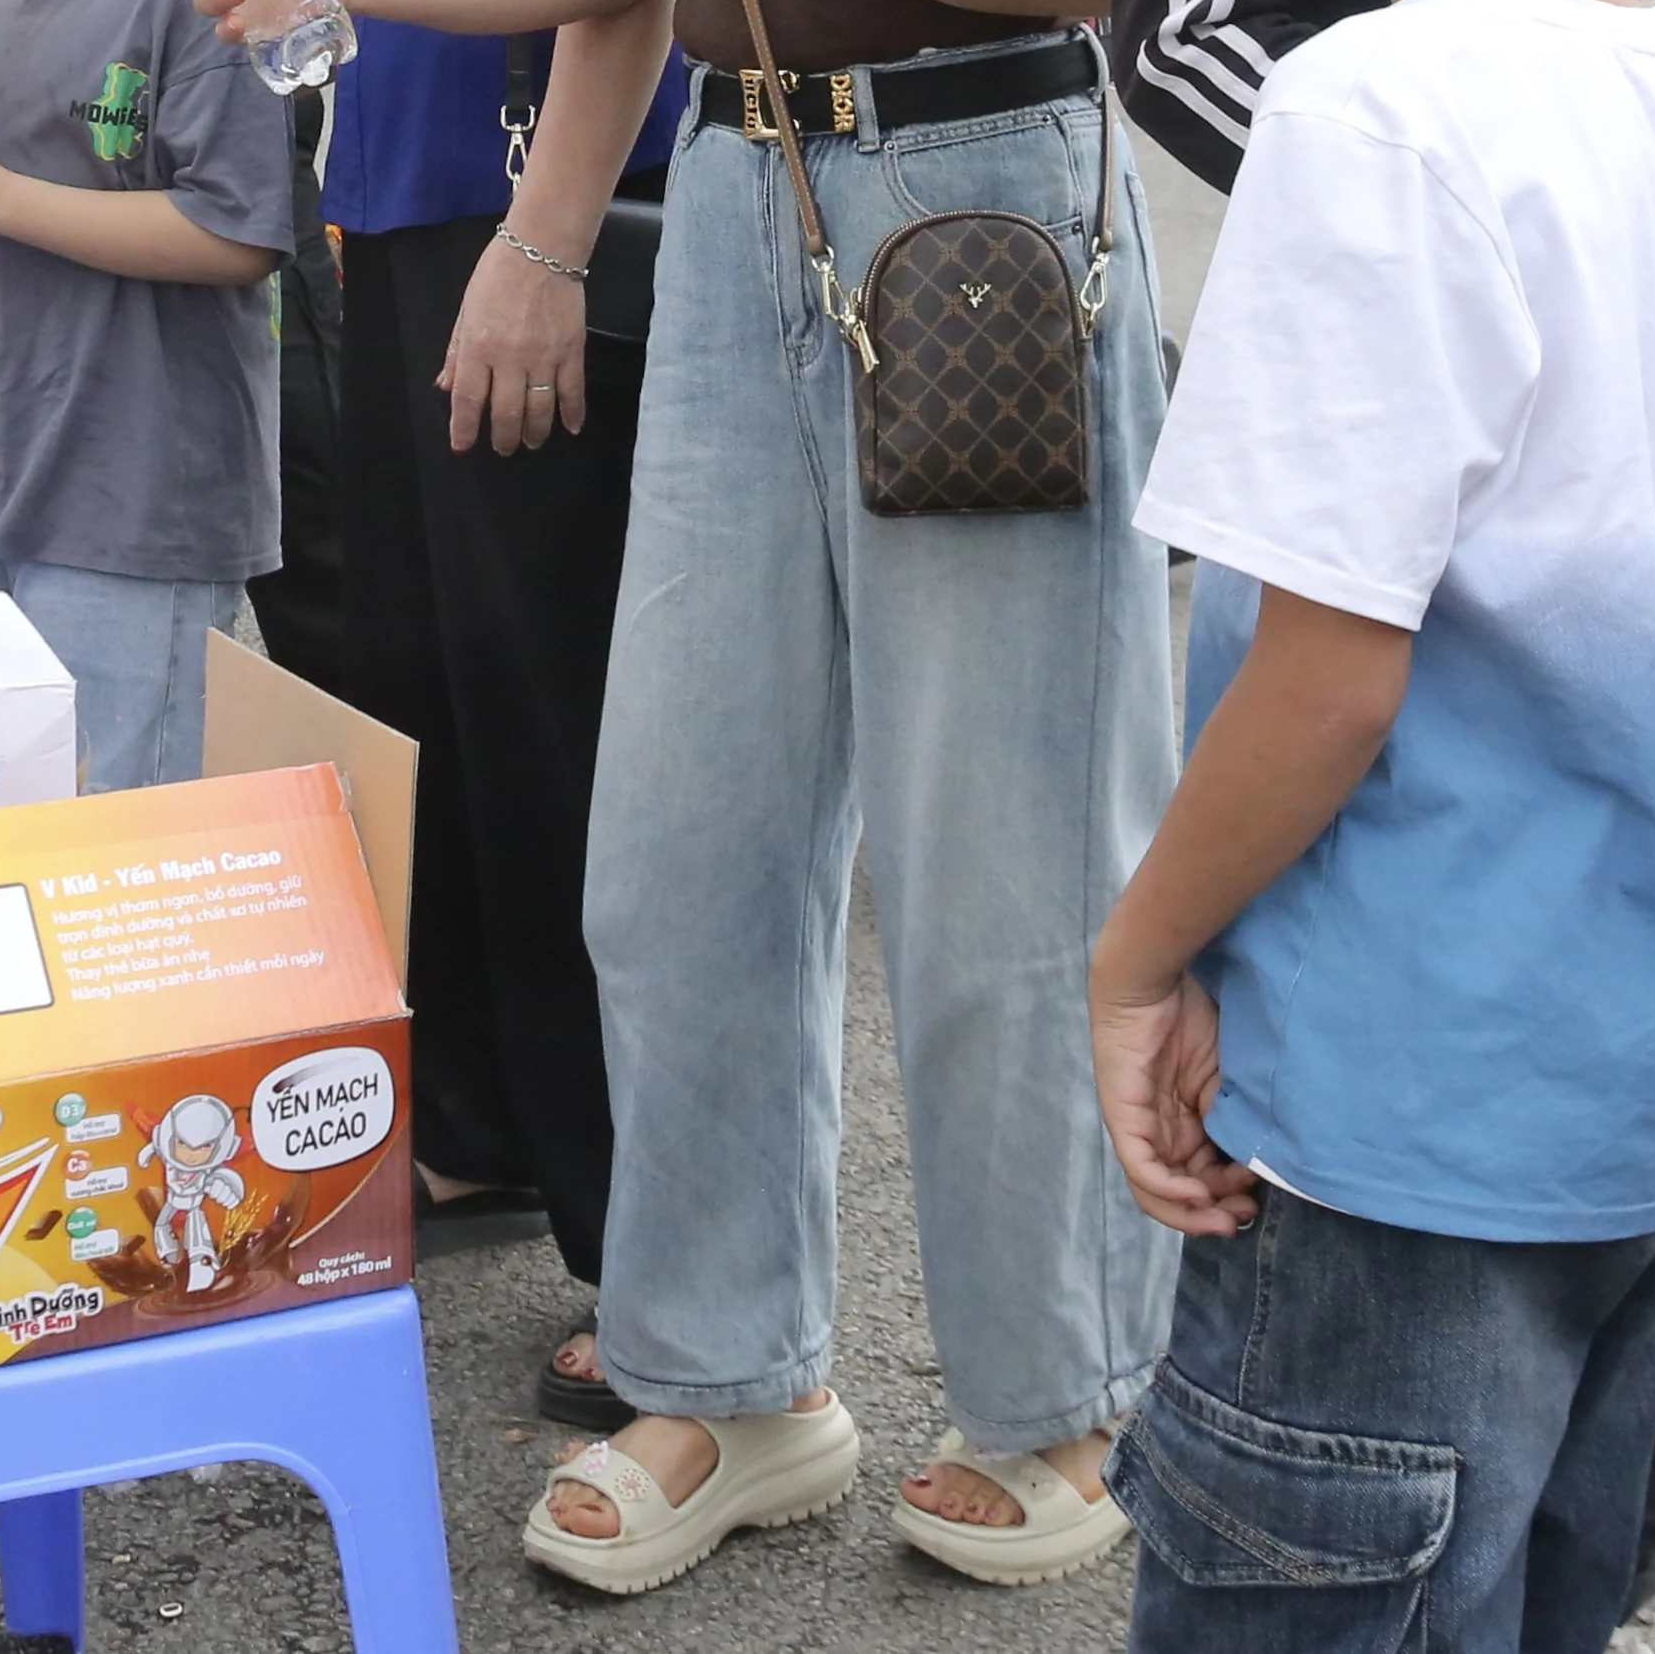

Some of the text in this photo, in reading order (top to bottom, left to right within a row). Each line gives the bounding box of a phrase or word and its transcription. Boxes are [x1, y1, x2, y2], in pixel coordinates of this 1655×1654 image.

[40, 878, 55, 899] V
[61, 872, 99, 897] Kid
[114, 863, 156, 888] Yến
[160, 856, 216, 882] Mạch
[220, 849, 282, 872] Cacao
[266, 1072, 379, 1124] YẾN MẠCH
[285, 1111, 367, 1157] CACAO
[315, 1268, 340, 1285] hộp
[341, 1266, 350, 1278] x
[375, 1255, 392, 1271] ml
[30, 1287, 100, 1317] Dưỡng
[44, 1312, 73, 1330] Em
